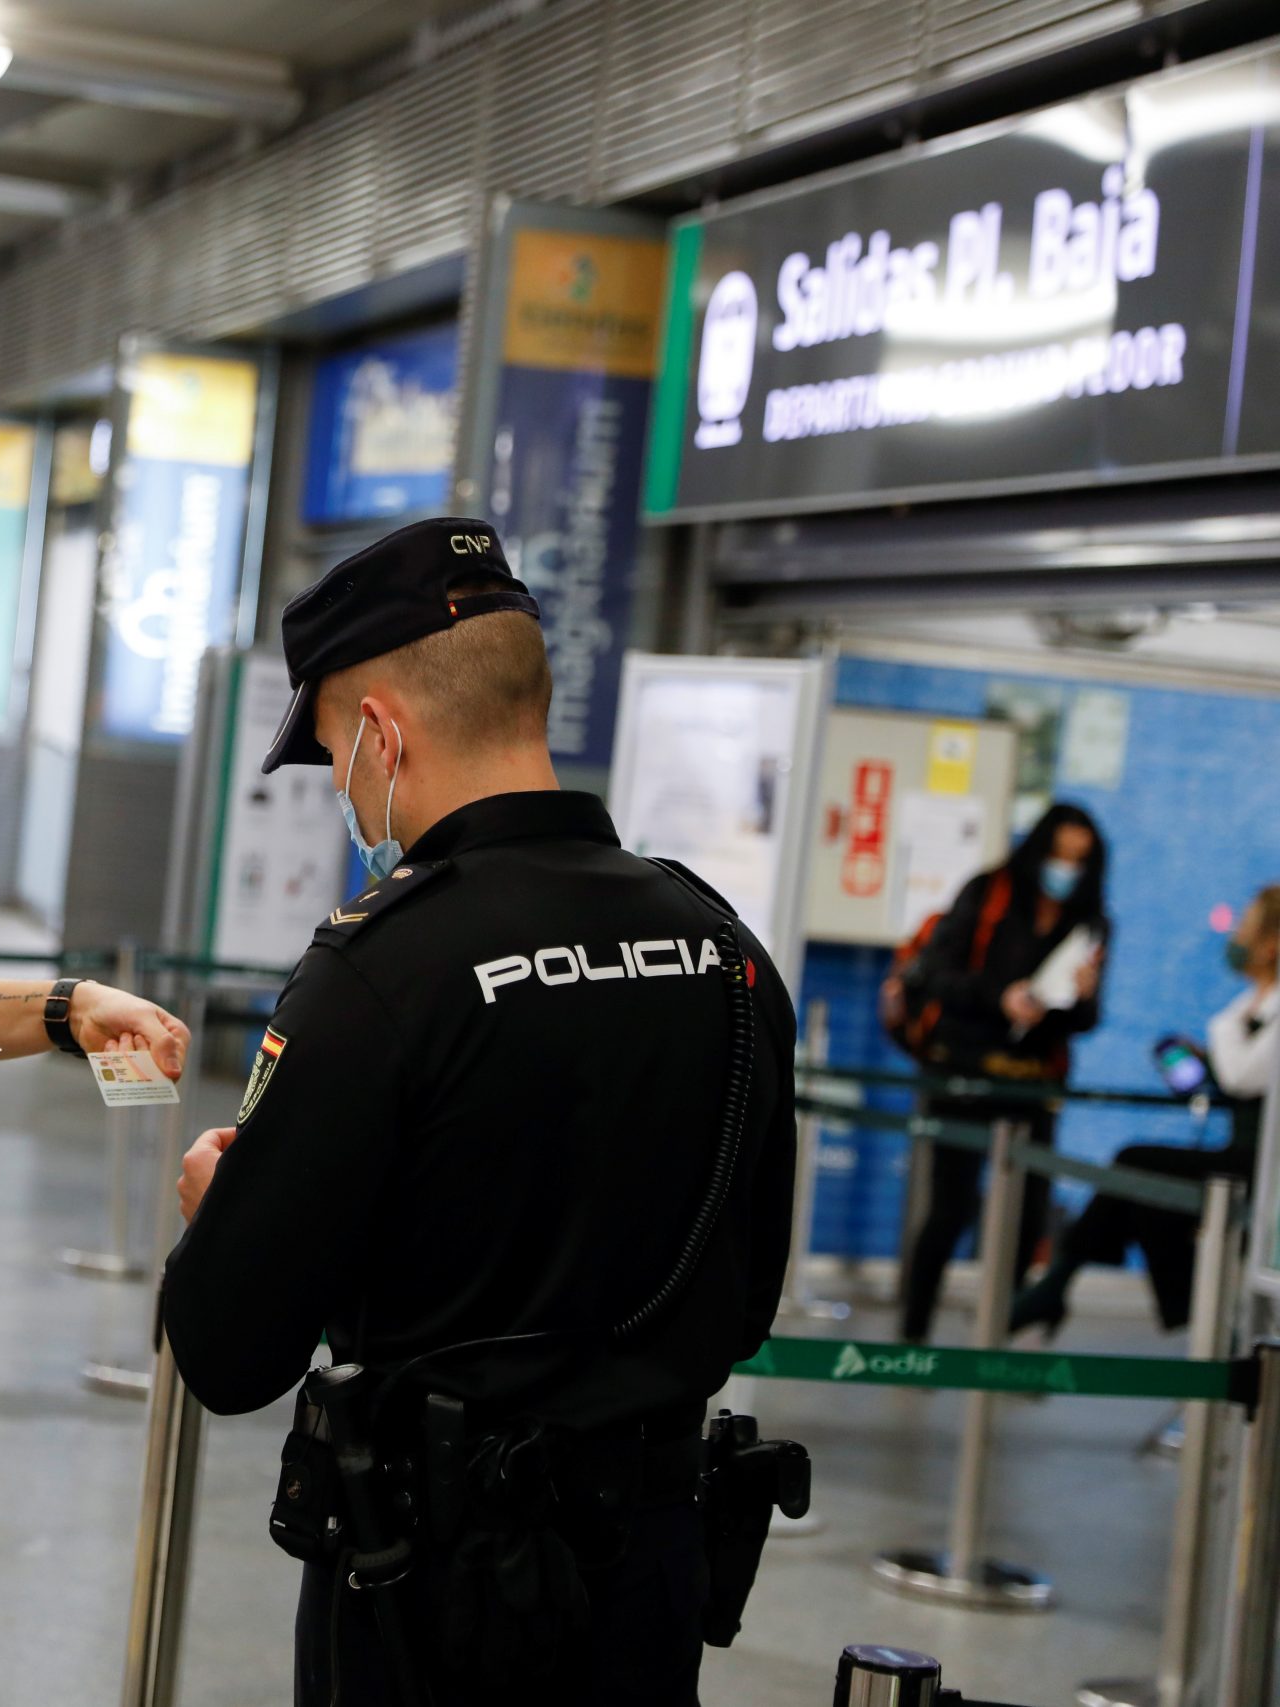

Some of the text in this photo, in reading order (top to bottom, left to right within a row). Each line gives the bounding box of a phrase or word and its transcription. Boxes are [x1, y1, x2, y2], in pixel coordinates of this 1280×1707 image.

[772, 229, 940, 351] Salidas
[1029, 164, 1160, 310] Baja
[450, 535, 491, 554] CNP
[473, 938, 722, 1004] POLICIA
[870, 1351, 937, 1376] adif
